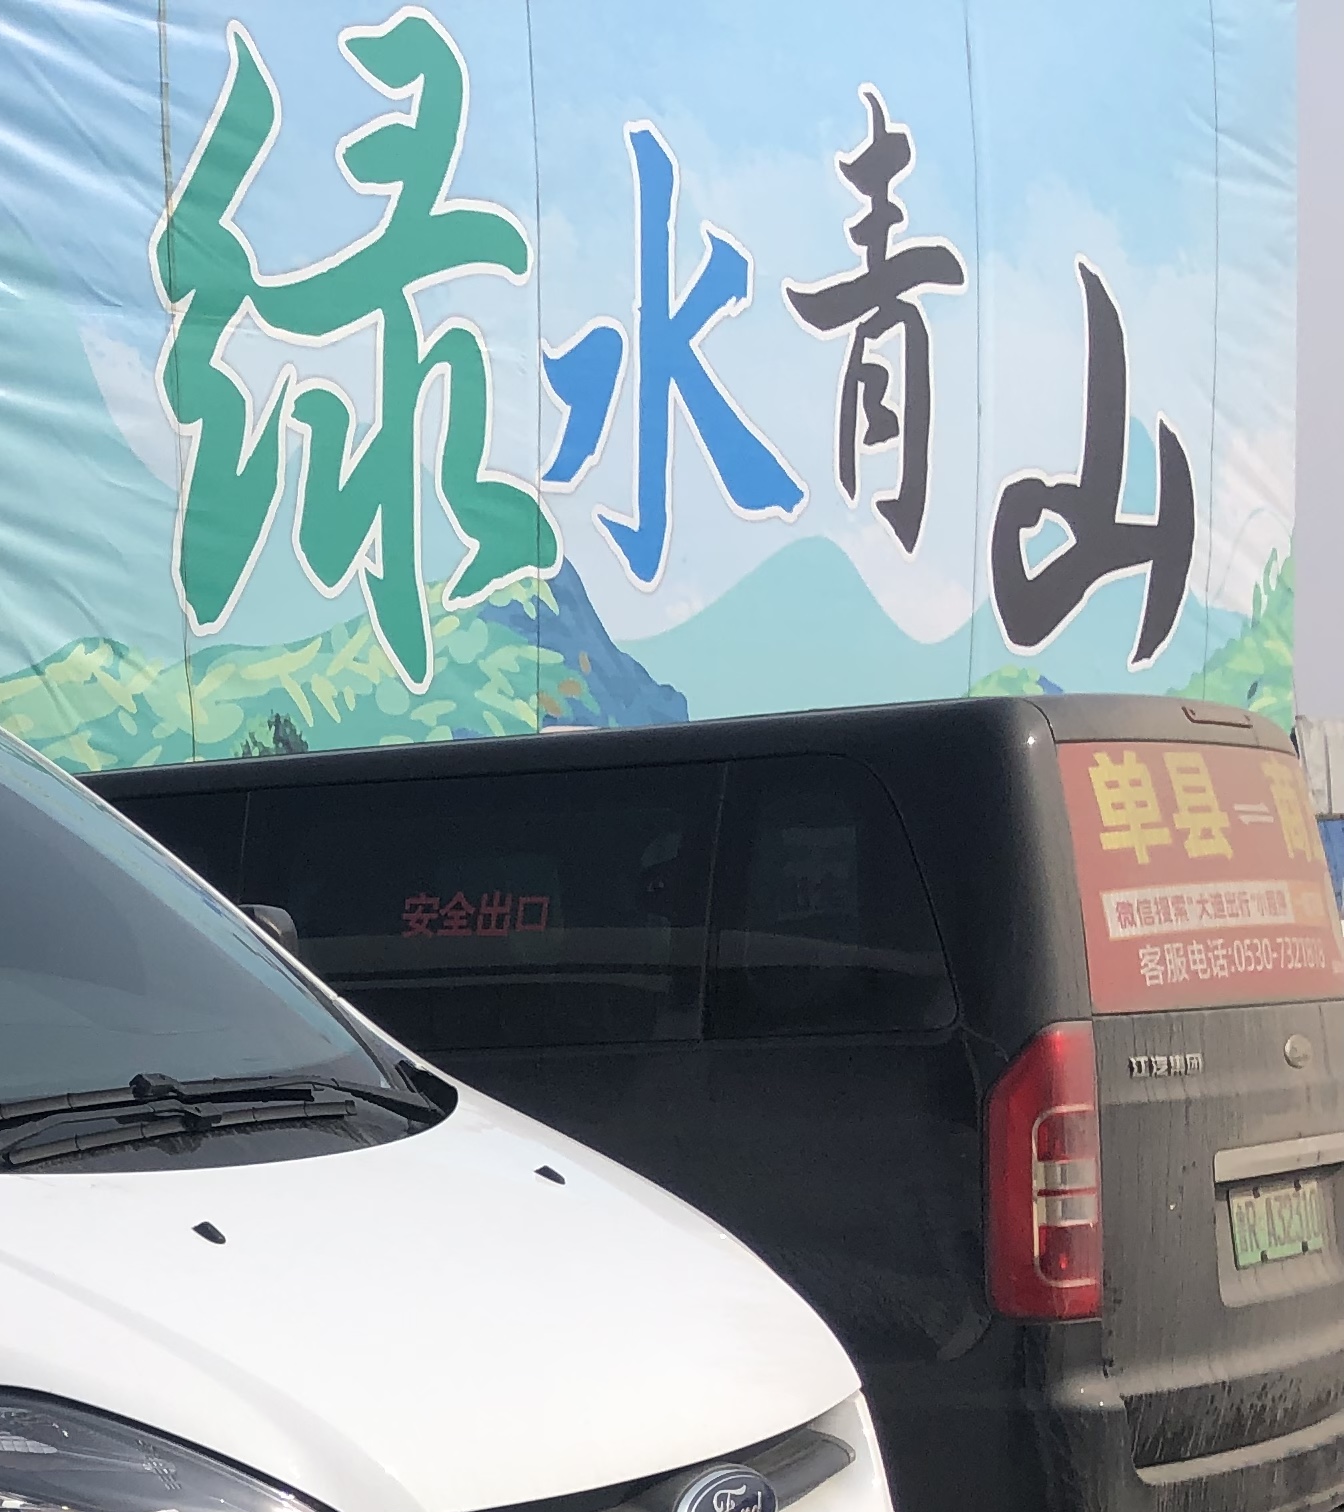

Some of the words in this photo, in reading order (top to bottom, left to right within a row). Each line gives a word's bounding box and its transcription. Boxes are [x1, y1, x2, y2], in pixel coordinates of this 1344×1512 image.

[154, 8, 1193, 691] 绿水青山
[1088, 750, 1233, 864] 单县
[402, 891, 550, 938] 安全出口
